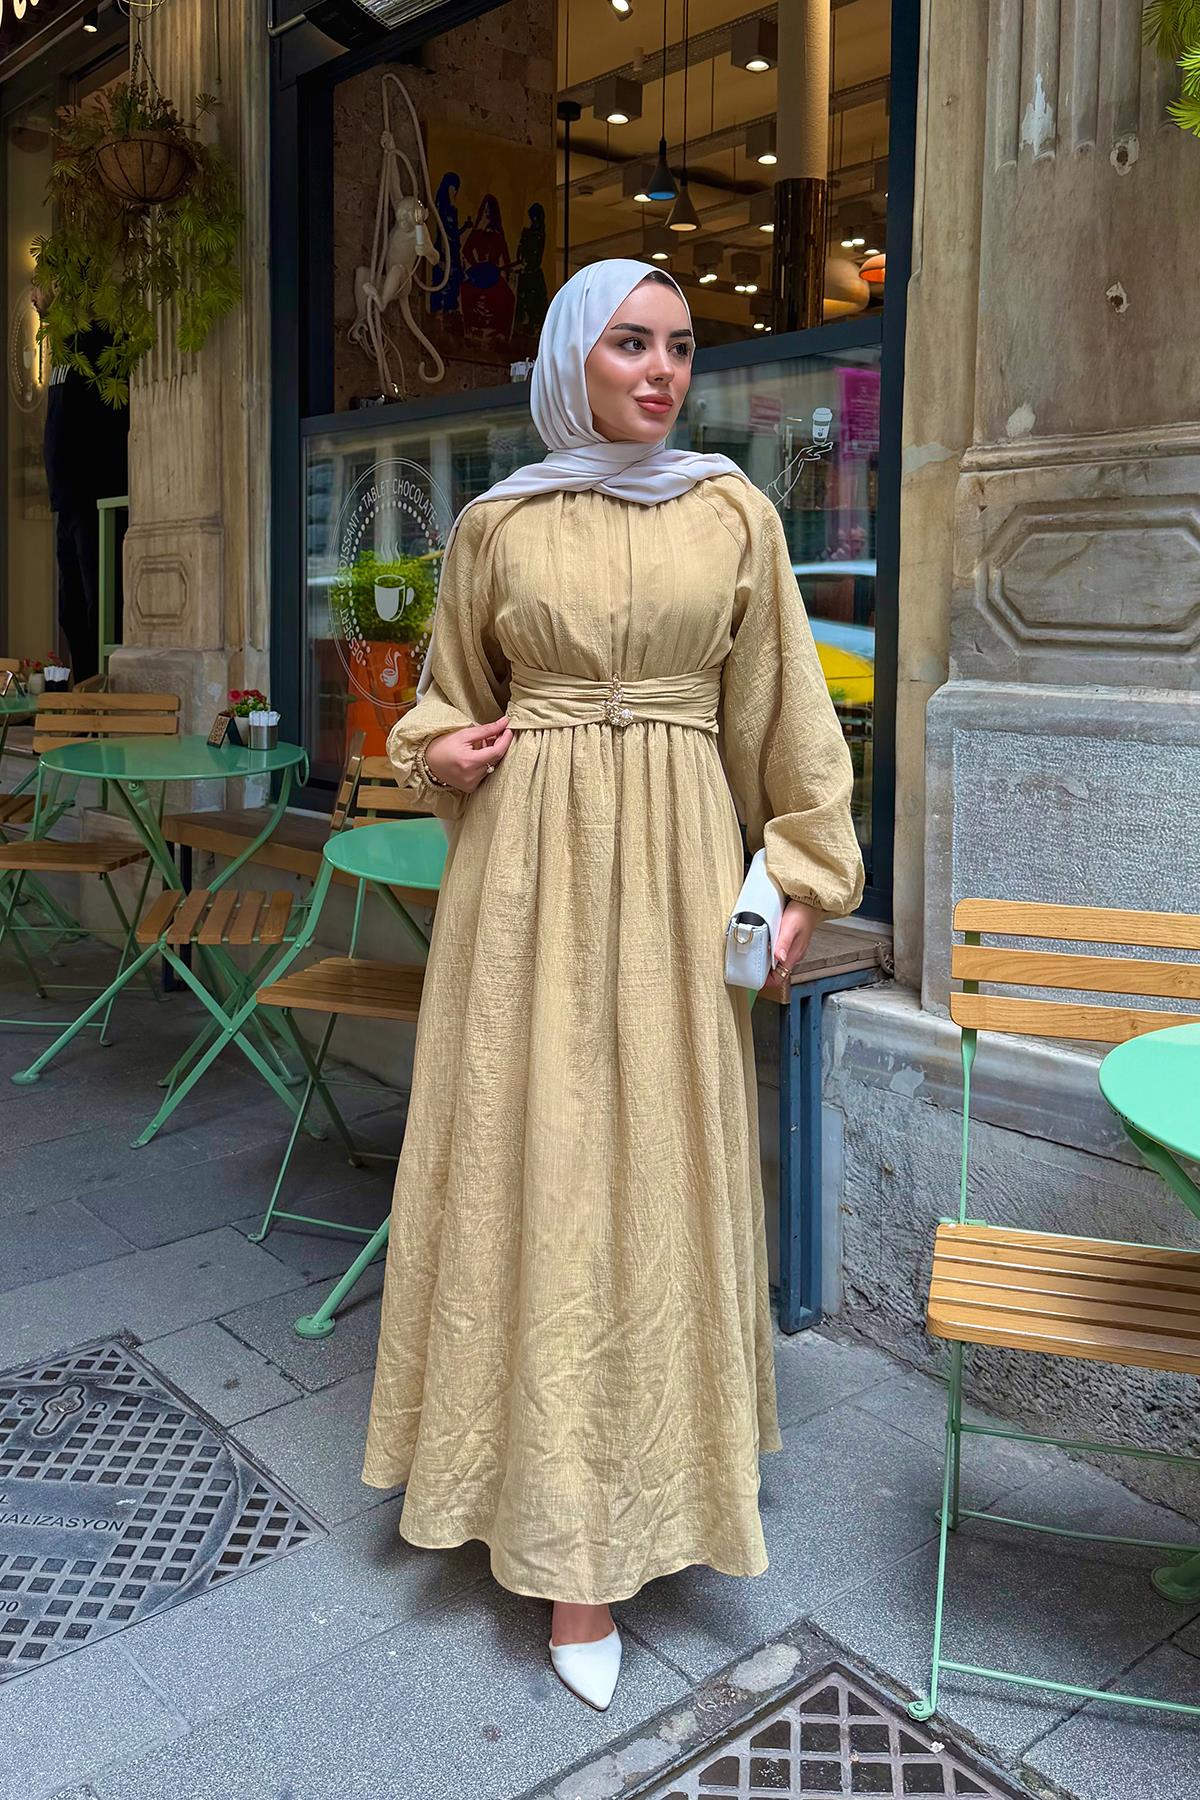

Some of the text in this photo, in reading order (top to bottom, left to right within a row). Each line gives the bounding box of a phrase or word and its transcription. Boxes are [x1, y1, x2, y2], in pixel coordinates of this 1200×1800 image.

[337, 478, 438, 664] DESSERT CROISSANT TABLET CHOCOLATE
